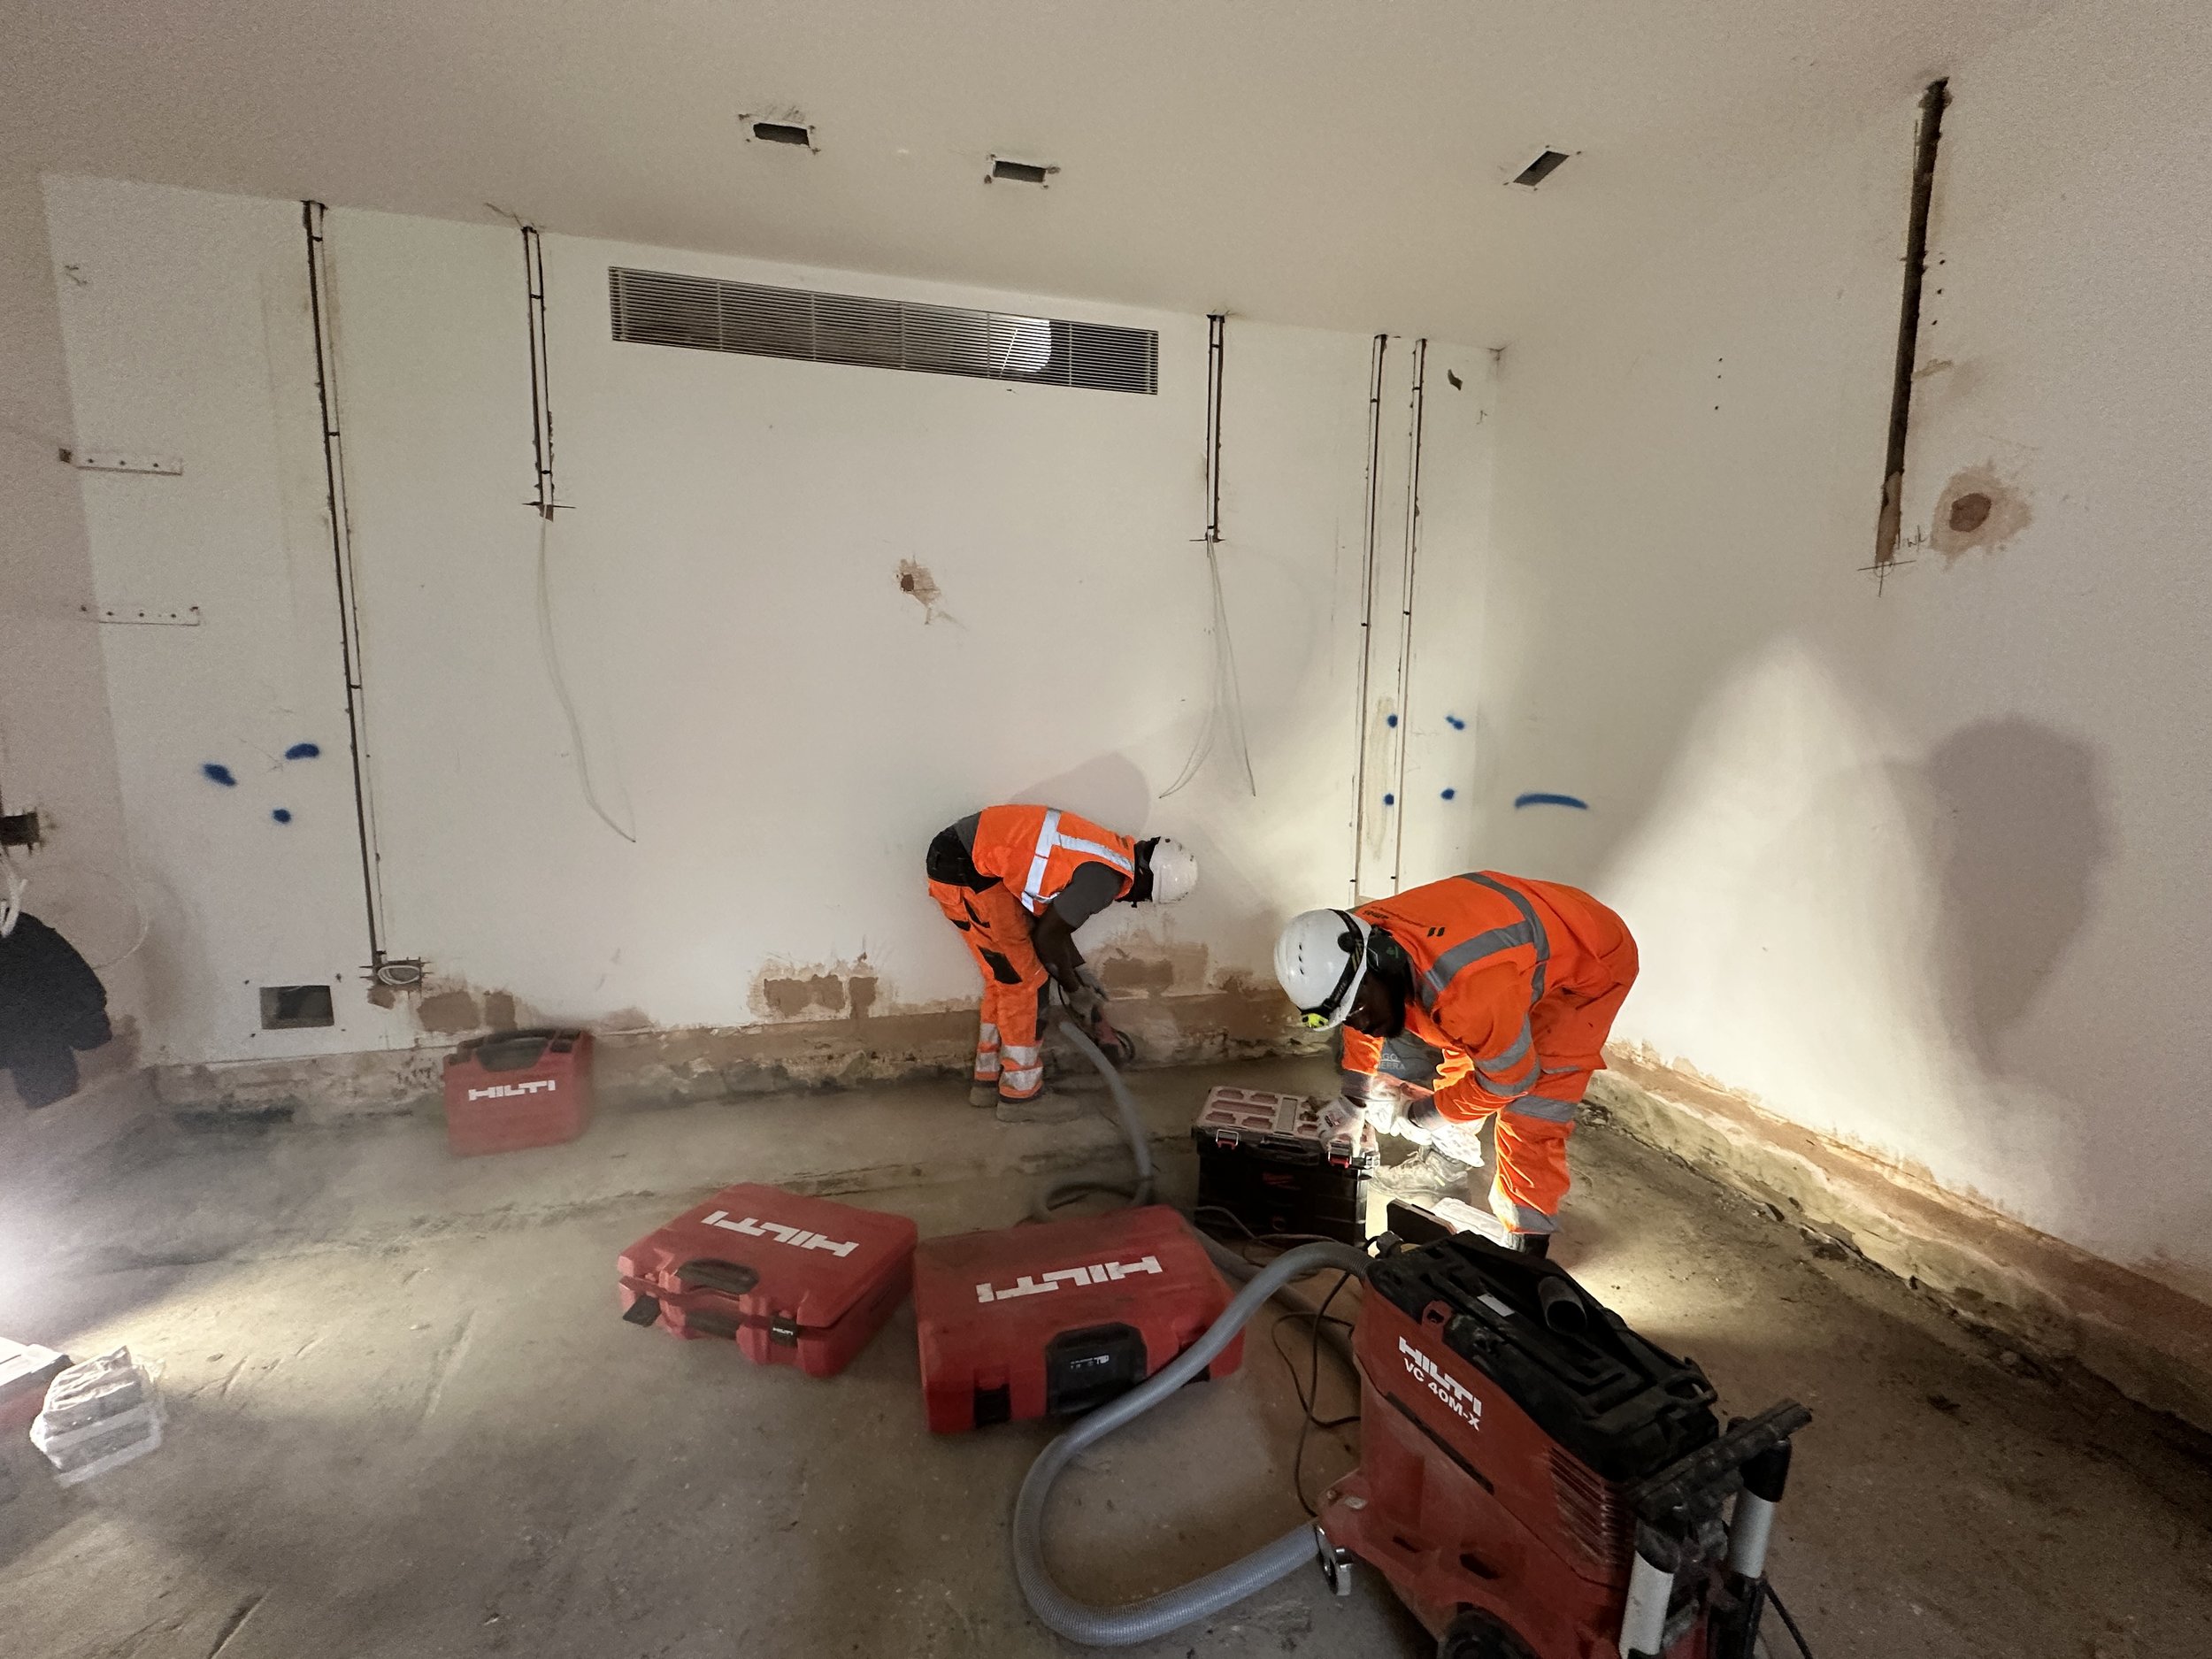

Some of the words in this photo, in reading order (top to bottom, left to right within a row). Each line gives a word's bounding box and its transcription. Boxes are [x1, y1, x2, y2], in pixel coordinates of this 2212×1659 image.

[468, 1079, 556, 1101] HILTI
[701, 1210, 859, 1257] HILTI
[976, 1256, 1163, 1303] HILTI
[1399, 1336, 1482, 1417] HILTI
[1403, 1357, 1425, 1382] VC
[1427, 1381, 1480, 1431] 40M-X
